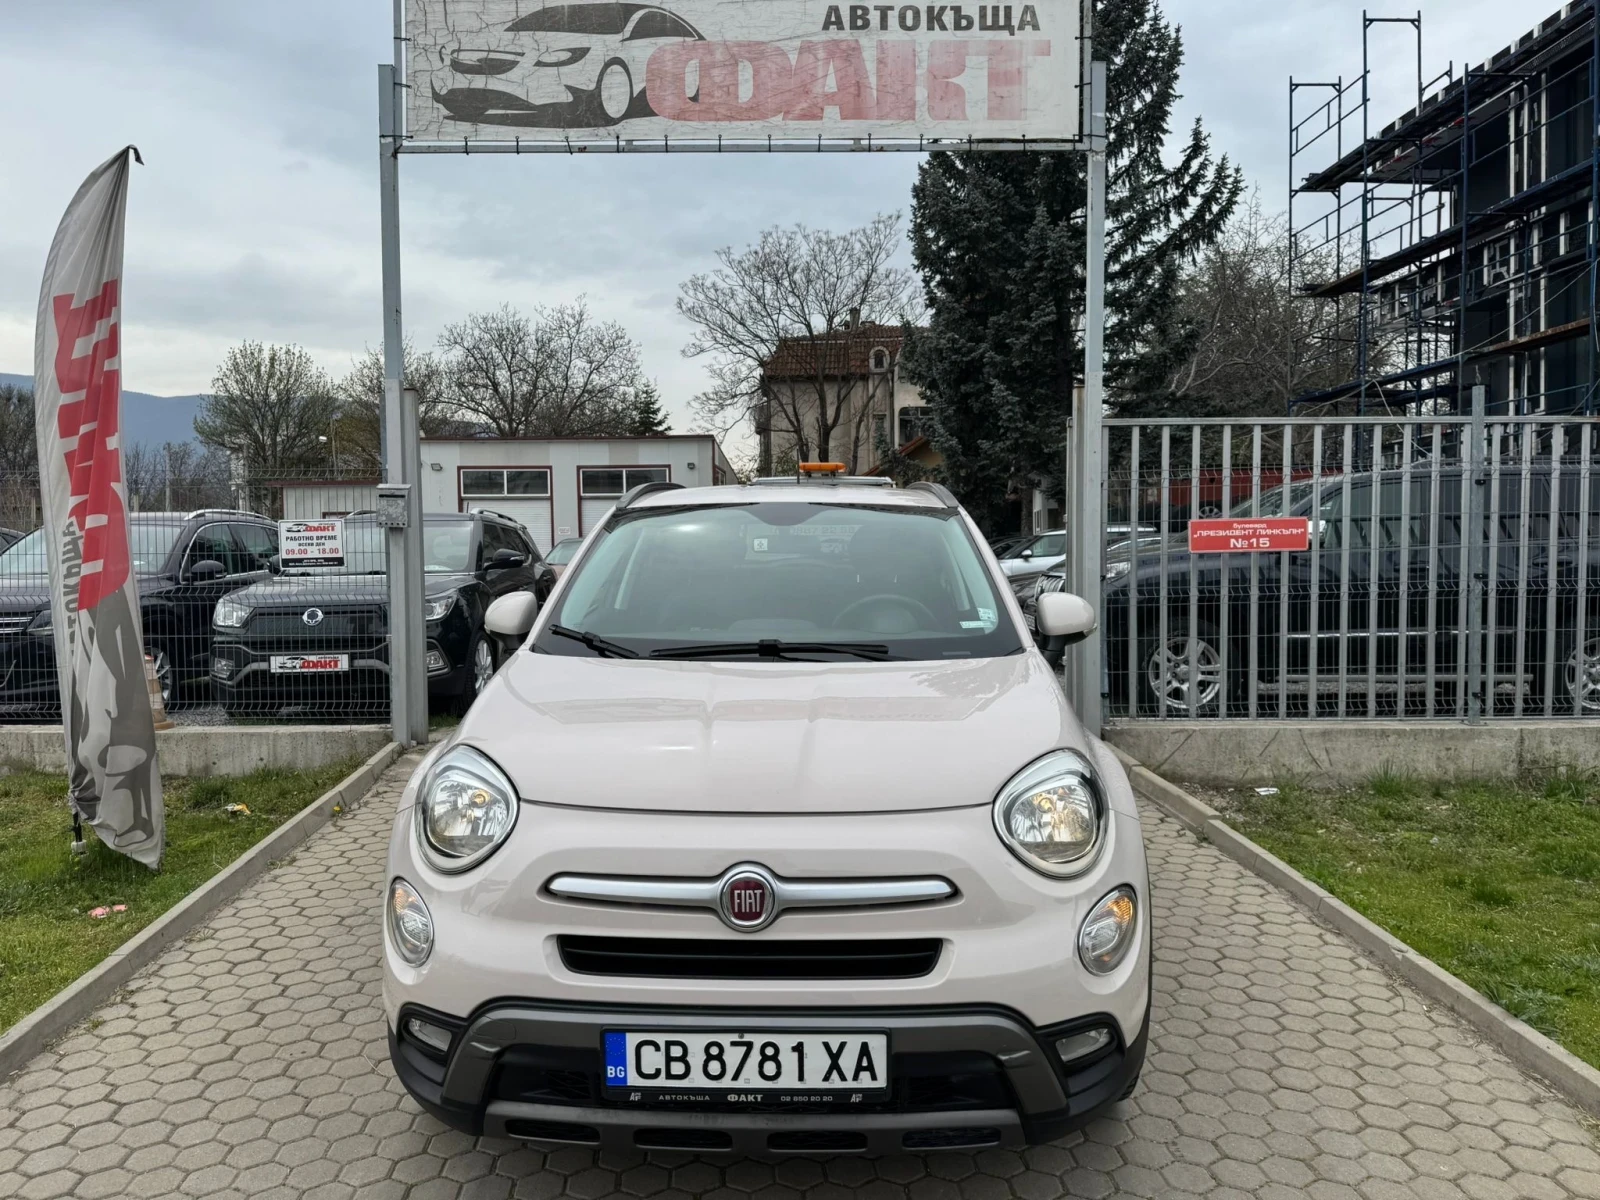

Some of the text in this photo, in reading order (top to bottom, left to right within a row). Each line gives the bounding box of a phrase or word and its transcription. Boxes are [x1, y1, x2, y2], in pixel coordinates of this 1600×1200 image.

[821, 5, 1041, 36] АВТОКЪЩА
[645, 40, 1051, 121] ФАКТ
[734, 889, 763, 913] FIAT
[607, 1066, 625, 1078] BG
[634, 1040, 878, 1082] CB 8781 XA
[727, 1093, 763, 1102] ФАКТ
